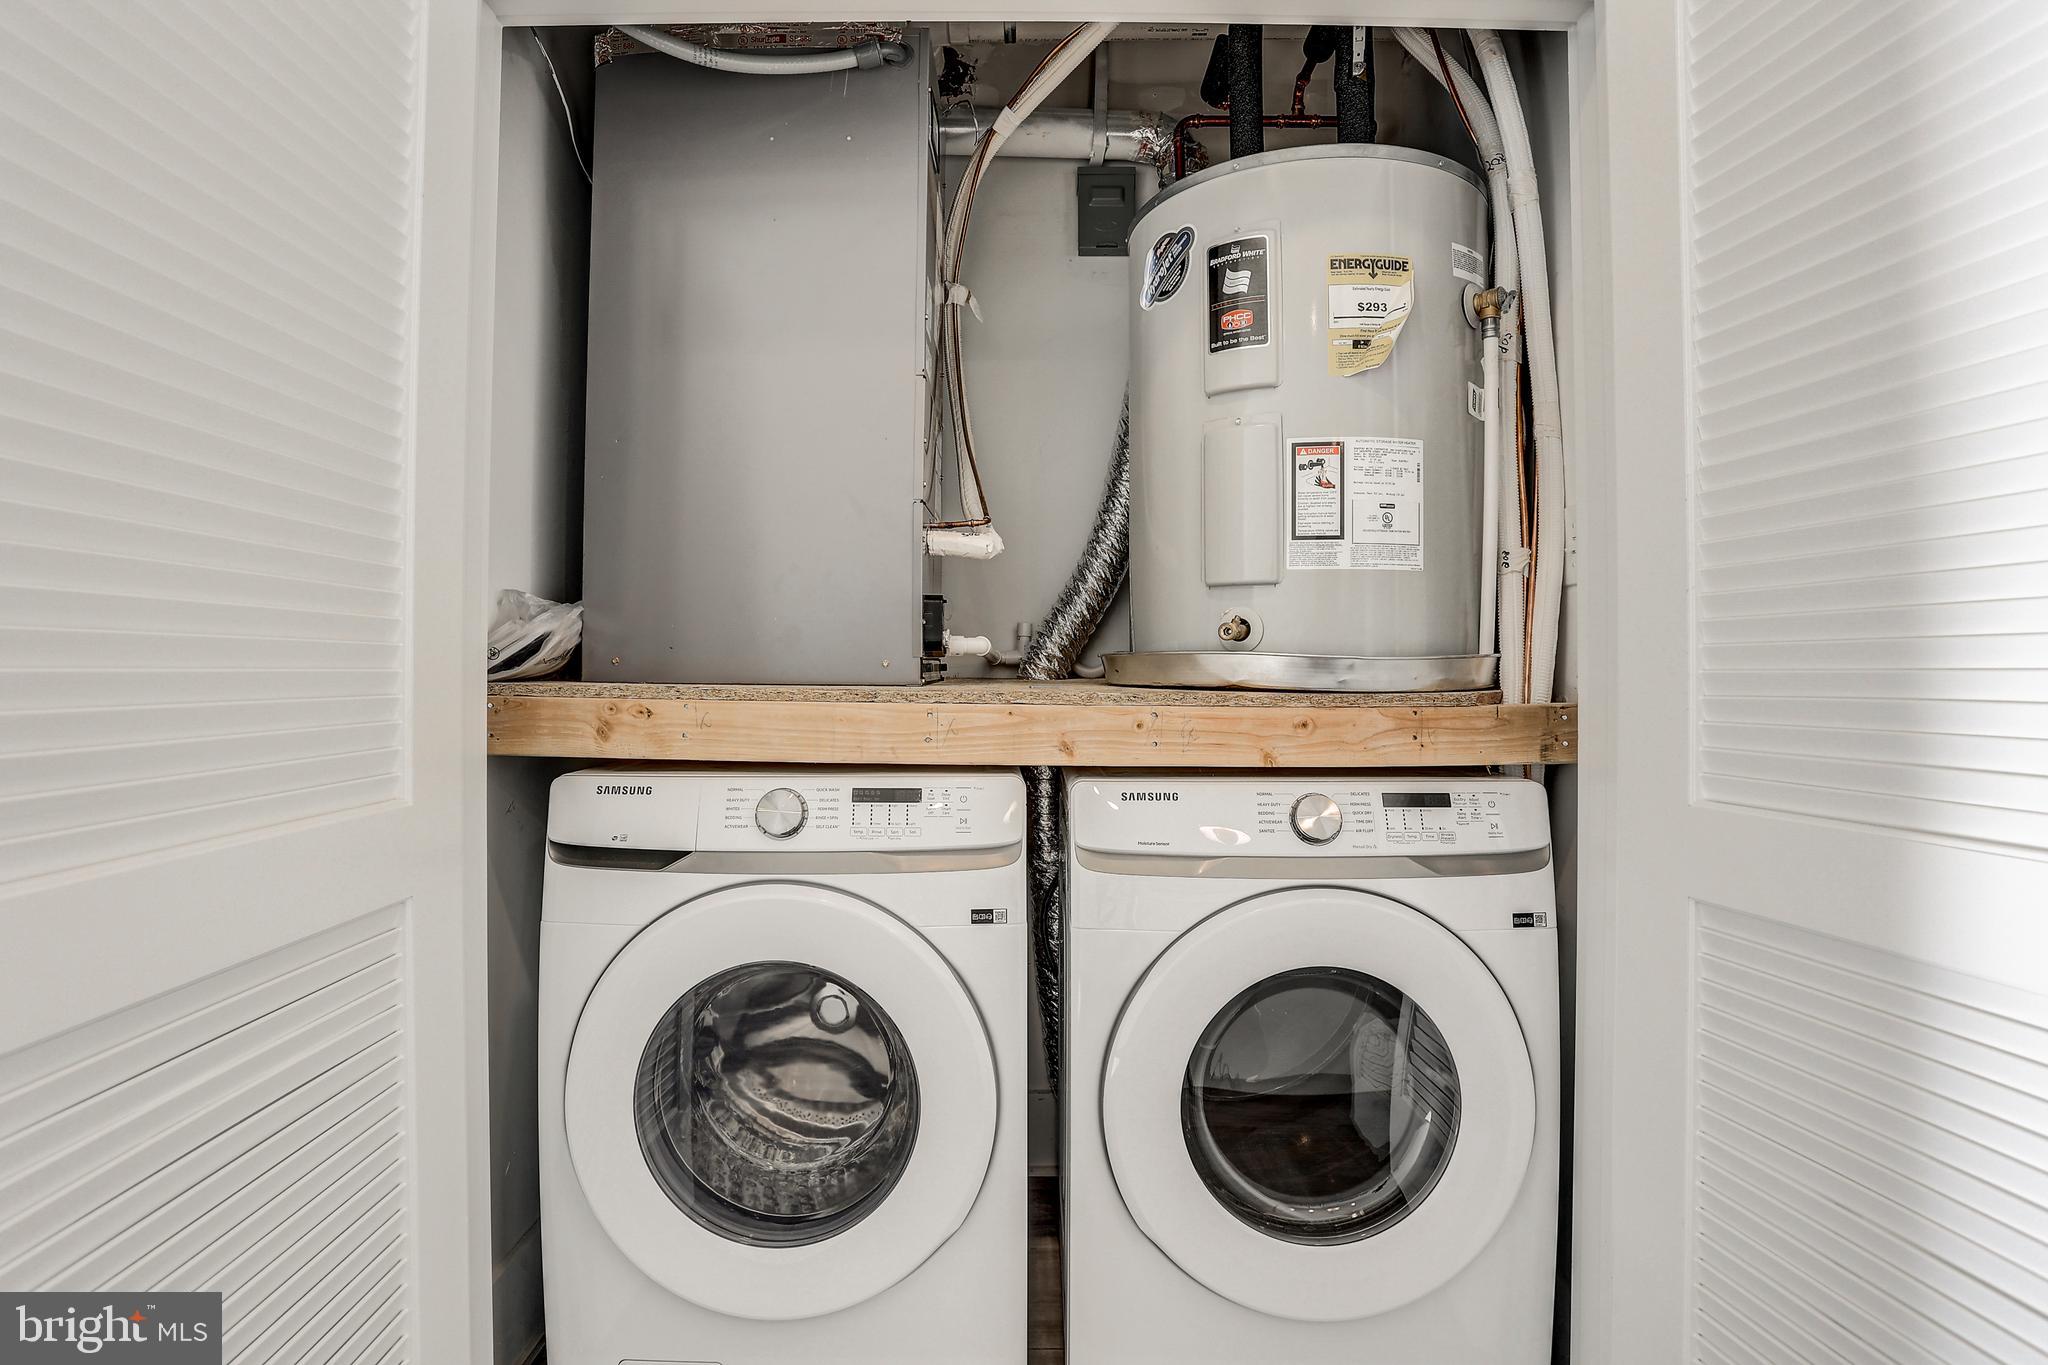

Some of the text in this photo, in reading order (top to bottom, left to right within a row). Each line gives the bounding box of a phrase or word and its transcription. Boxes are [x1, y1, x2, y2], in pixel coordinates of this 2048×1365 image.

[1242, 250, 1264, 258] WHITE
[1330, 258, 1410, 272] ENERGYGUIDE
[1358, 302, 1388, 312] $293
[1223, 312, 1251, 323] PHCC
[596, 786, 652, 795] SAMSUNG
[1121, 792, 1178, 801] SAMSUNG
